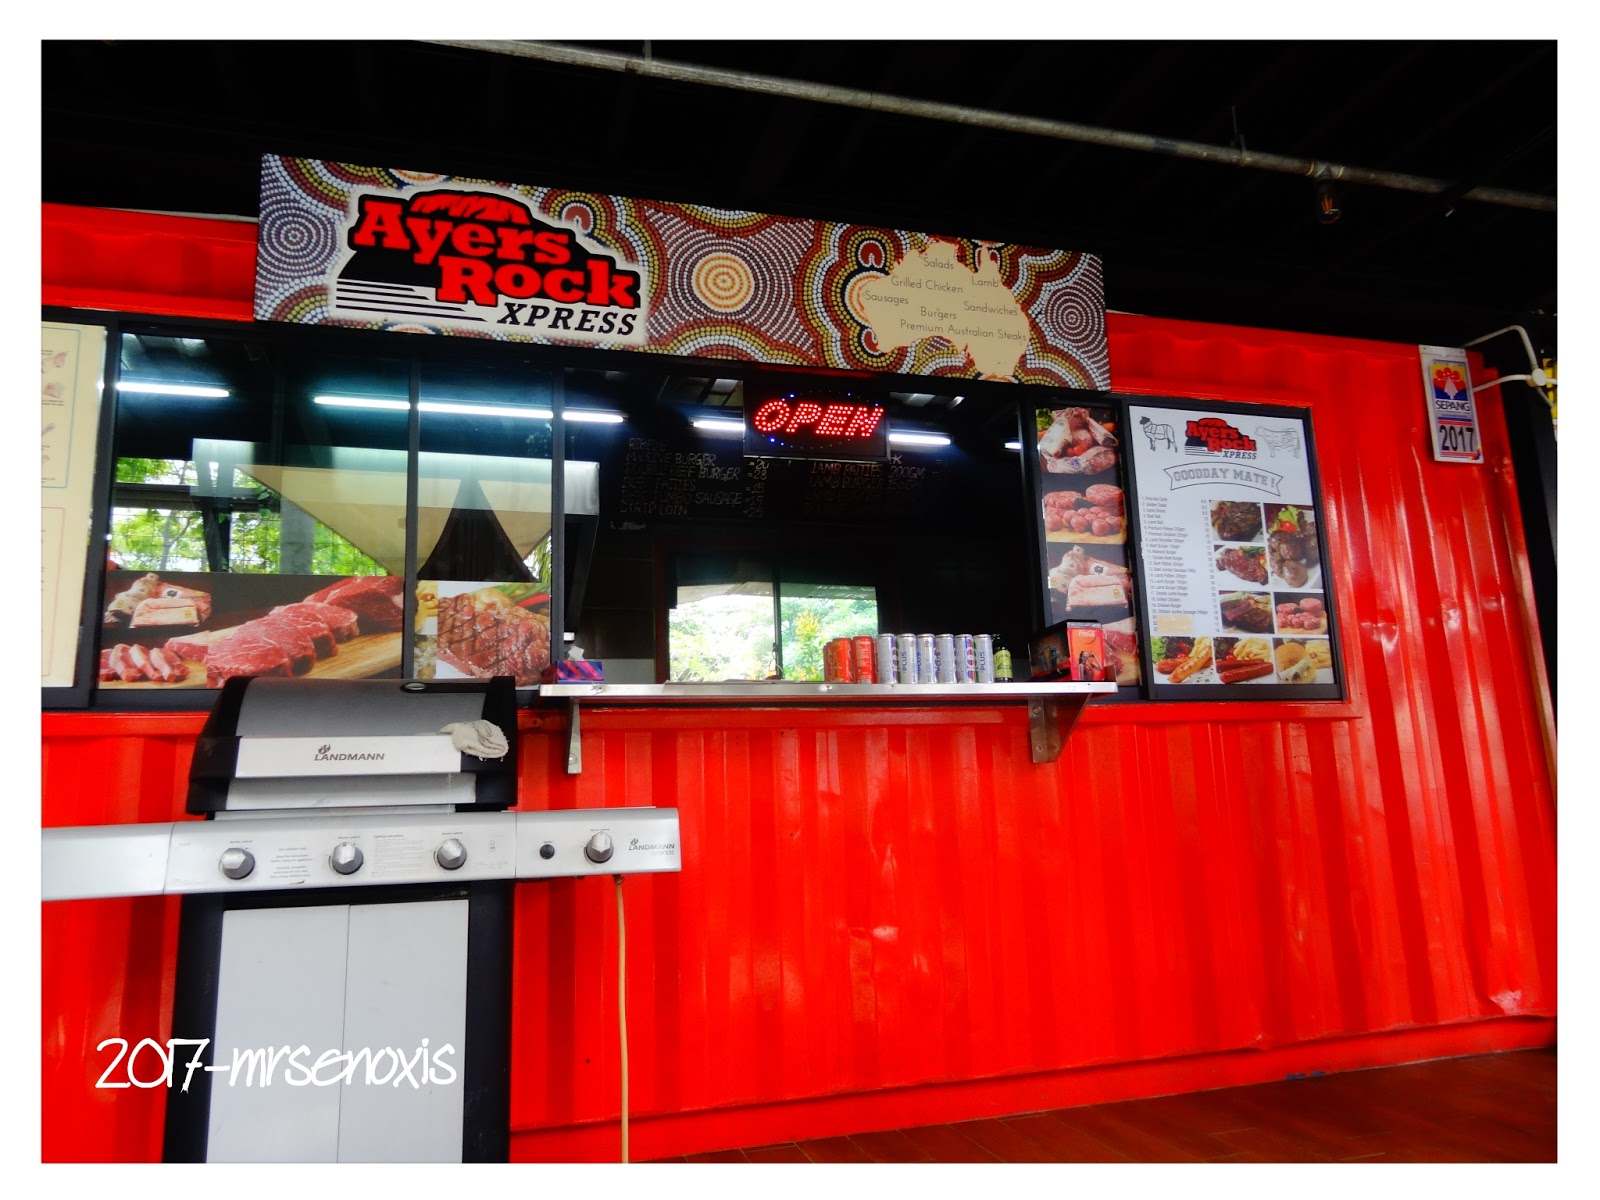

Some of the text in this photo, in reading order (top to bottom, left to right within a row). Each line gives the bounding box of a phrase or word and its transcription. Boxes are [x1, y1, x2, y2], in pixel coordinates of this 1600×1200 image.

[354, 200, 571, 265] Ayers
[923, 256, 955, 270] Salads
[435, 255, 635, 308] Rock
[890, 276, 963, 294] Grilled Chicken
[971, 278, 999, 288] Lamb
[864, 290, 909, 307] Sausages
[920, 306, 957, 321] Burgers
[963, 301, 1018, 316] Sandwiches
[499, 302, 638, 336] XPRESS
[900, 319, 1027, 342] Premium Australian Steaks
[1435, 400, 1470, 412] SEPANG
[755, 401, 884, 437] OPEN
[1186, 422, 1239, 441] Ayers
[1439, 425, 1474, 452] 2017
[1207, 435, 1257, 452] Rock
[1222, 451, 1257, 460] XPRESS
[1173, 467, 1230, 482] GOODDAY
[1232, 469, 1268, 486] MATE
[314, 753, 385, 762] LANDMANN
[628, 843, 675, 851] LANDMANN
